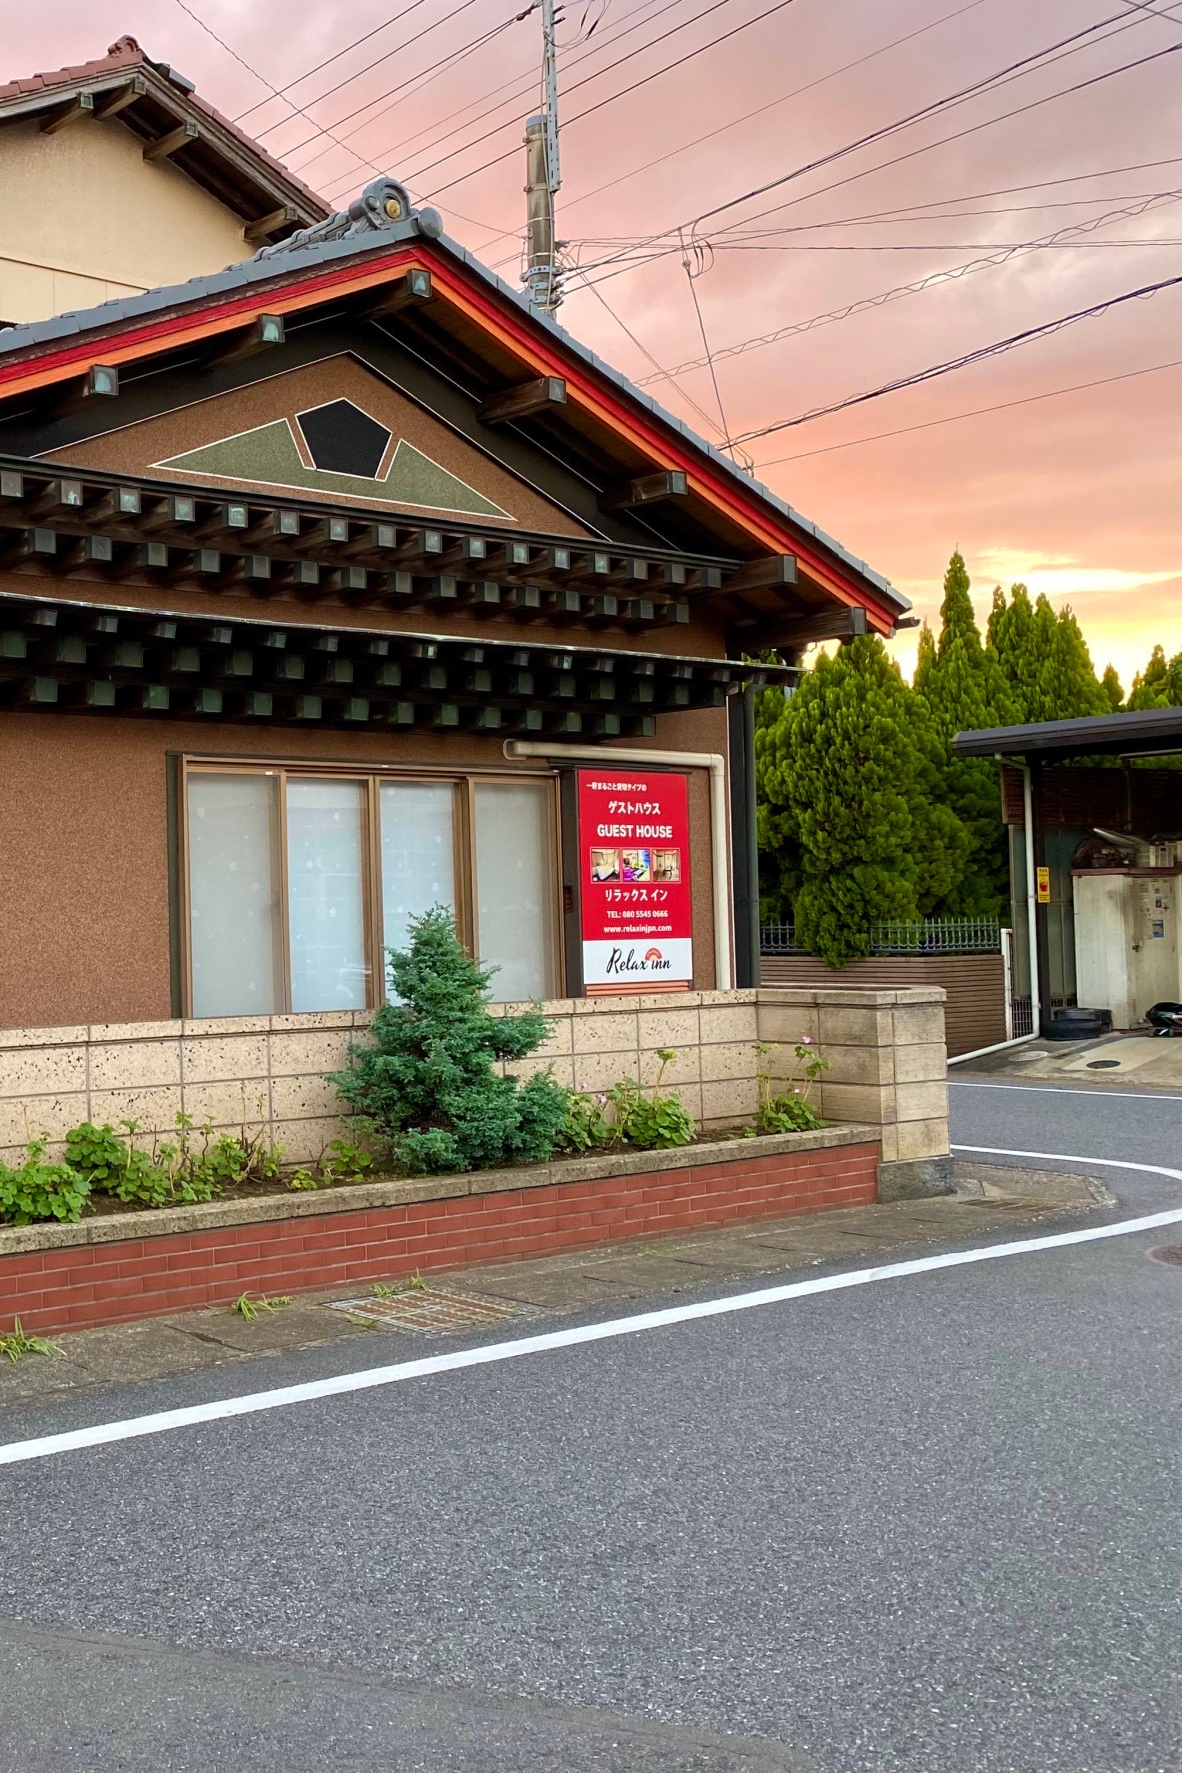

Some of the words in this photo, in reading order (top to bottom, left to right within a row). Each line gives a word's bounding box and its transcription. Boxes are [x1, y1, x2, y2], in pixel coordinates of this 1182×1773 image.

[608, 801, 661, 815] ゲストハウス
[597, 824, 634, 838] GUEST
[636, 825, 673, 838] HOUSE
[605, 889, 648, 902] リラックス
[651, 889, 668, 901] イン
[607, 910, 621, 918] TEL:
[622, 910, 635, 918] 080
[636, 910, 652, 918] 5545
[603, 924, 672, 934] www.relaxinjpn.com
[606, 947, 648, 974] Relax
